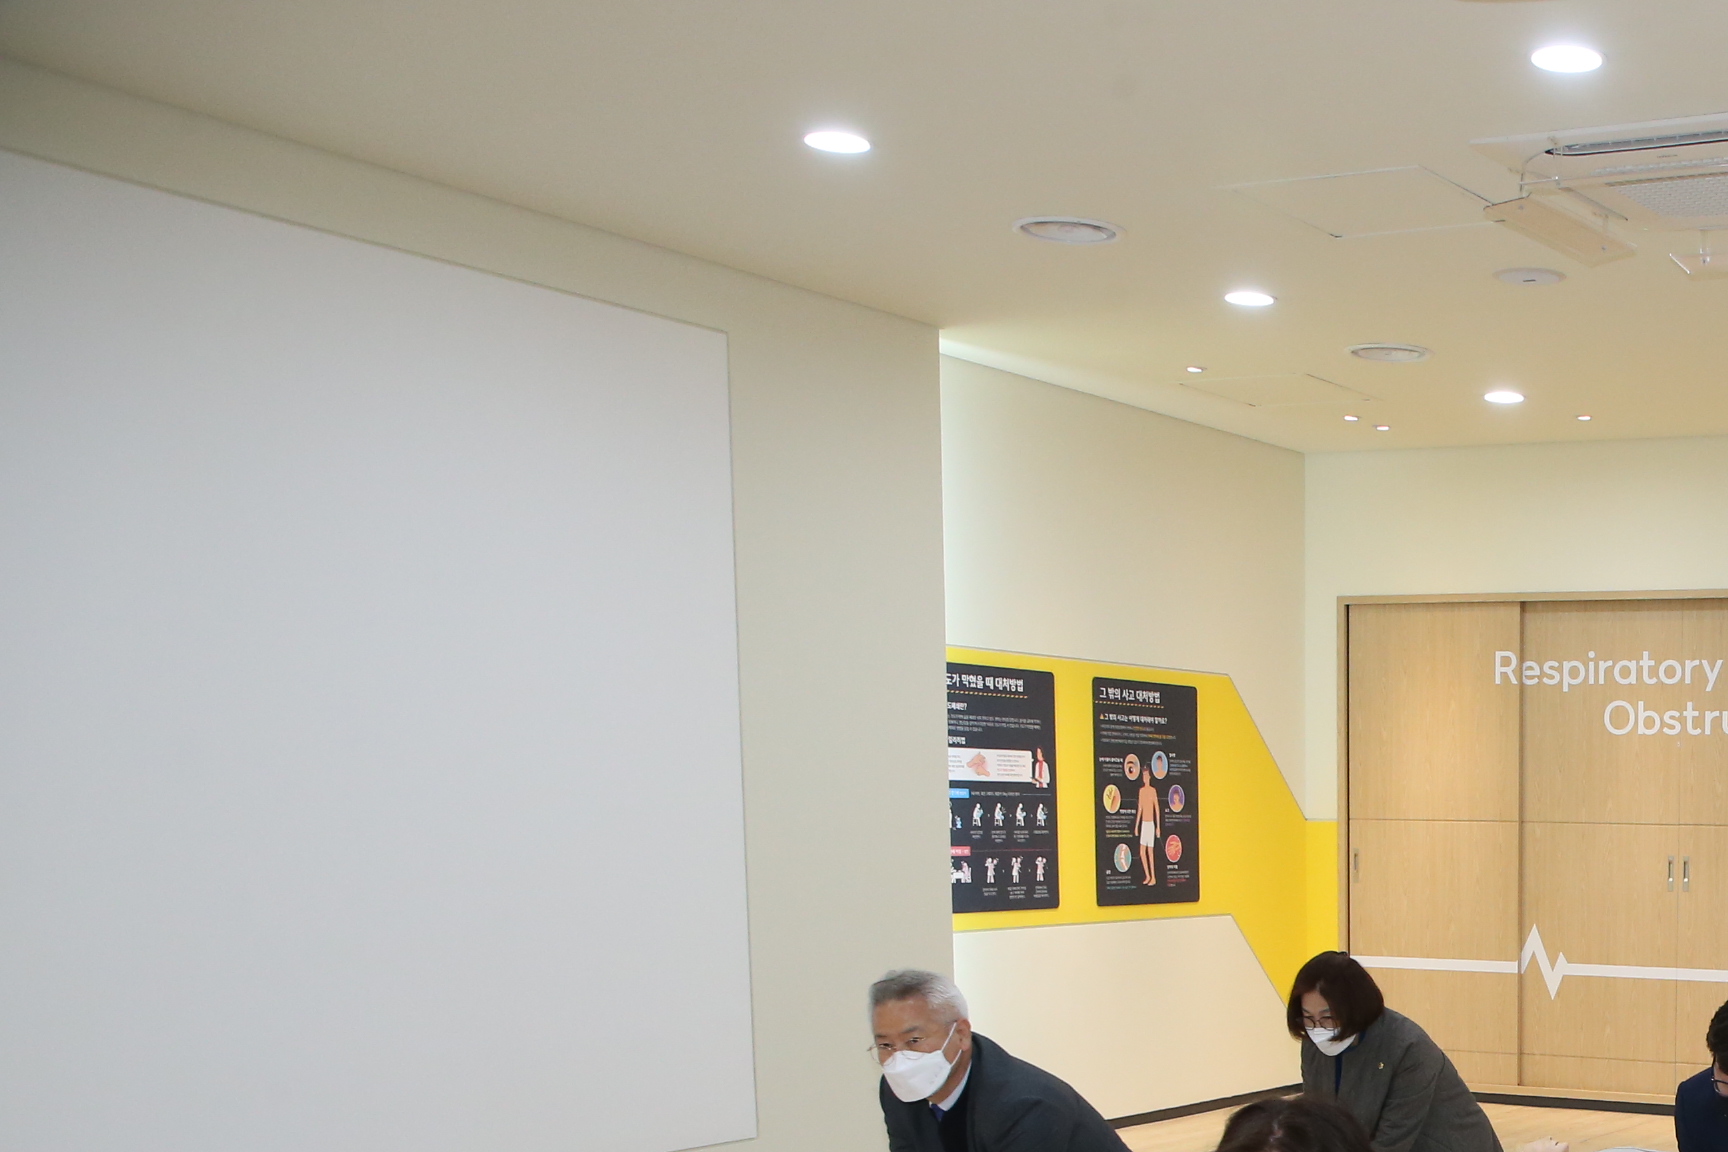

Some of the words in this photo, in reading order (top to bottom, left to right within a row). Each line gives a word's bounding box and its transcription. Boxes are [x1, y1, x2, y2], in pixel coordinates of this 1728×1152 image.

[1494, 650, 1724, 692] Respiratory
[985, 676, 994, 690] 때
[995, 677, 1024, 692] 대처방법
[1099, 687, 1107, 699] 그
[1108, 687, 1121, 700] 밖의
[1122, 688, 1136, 701] 사고
[1136, 690, 1161, 704] 대처방법
